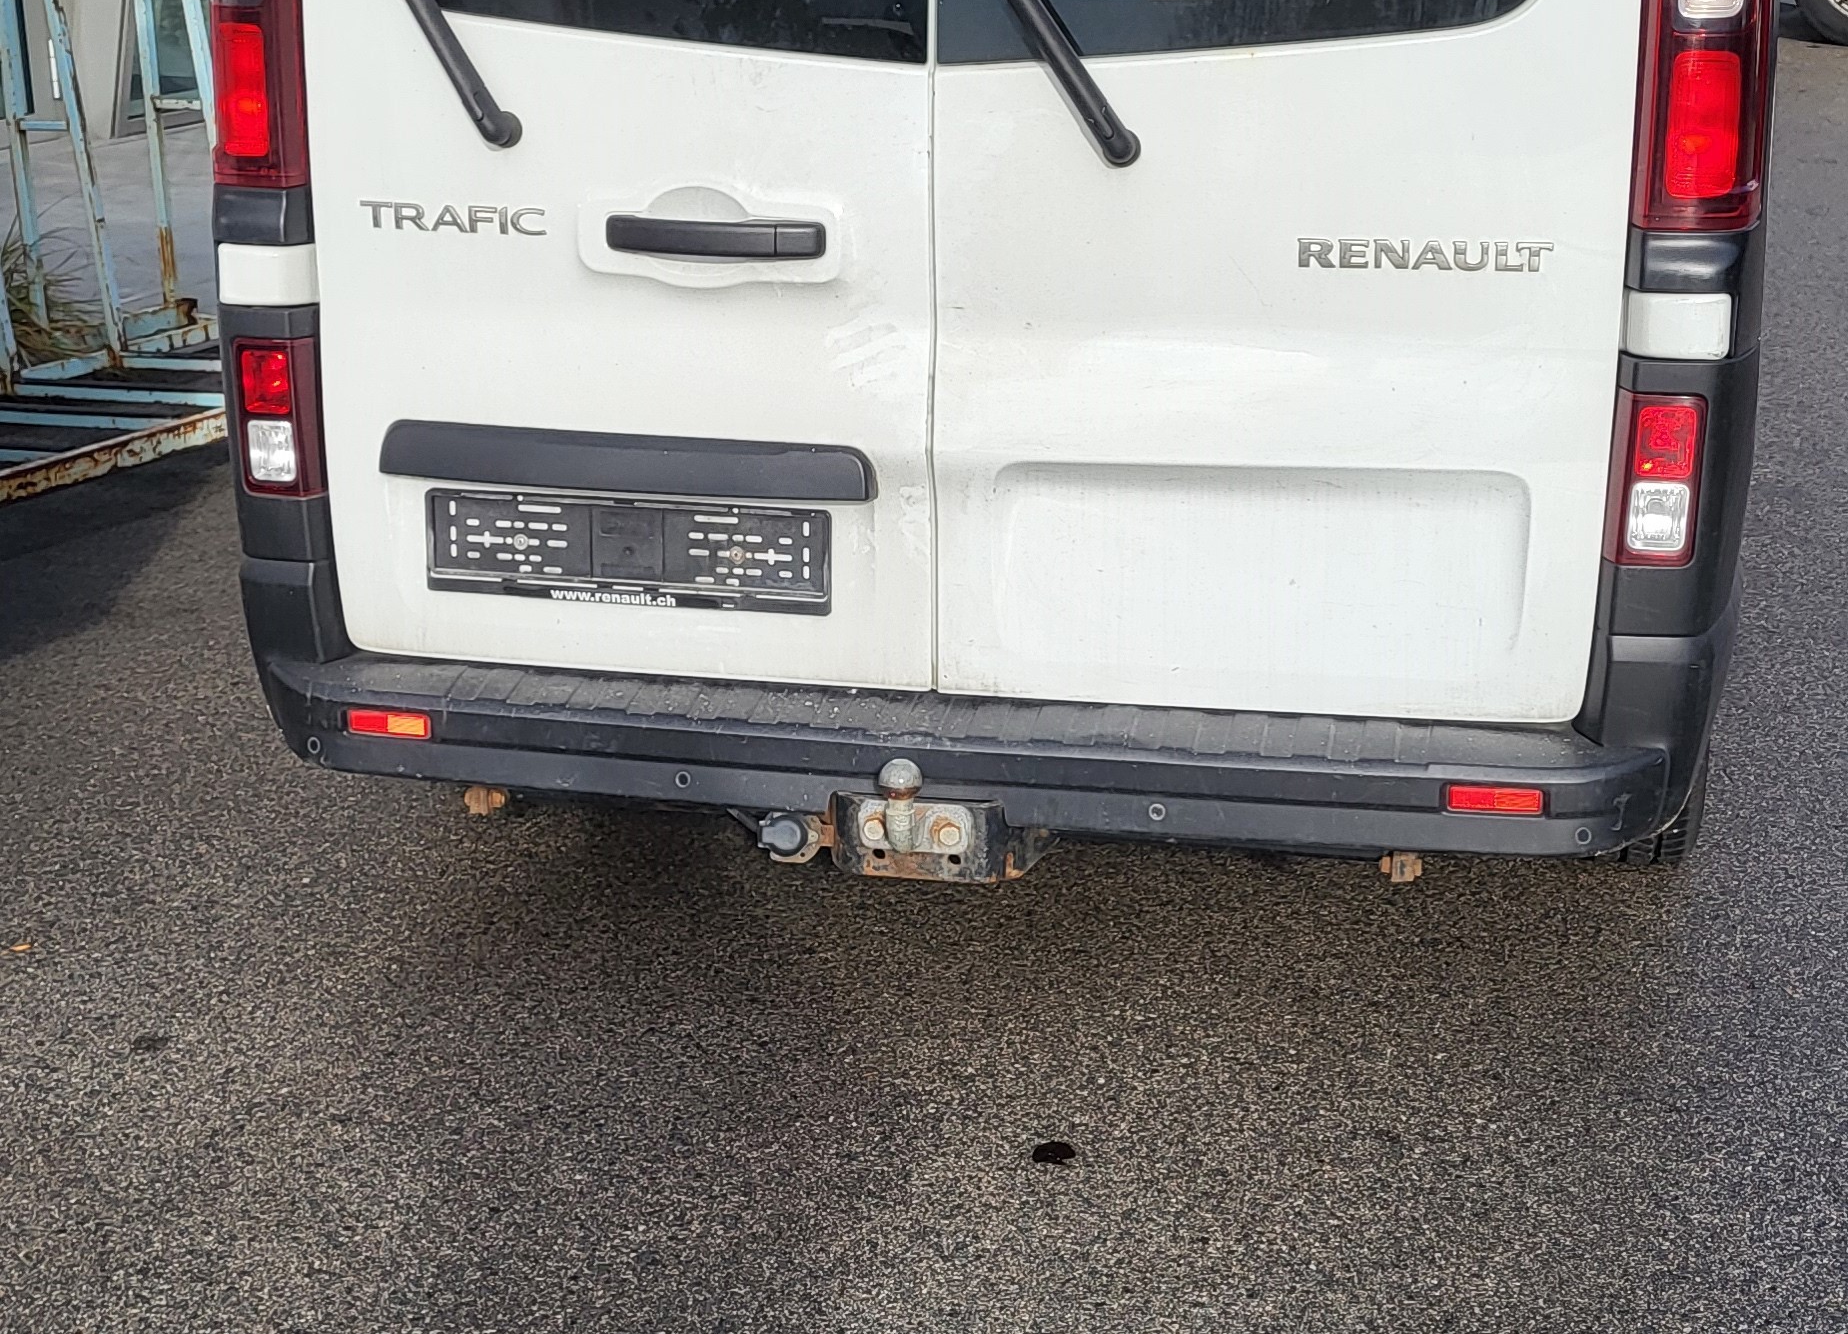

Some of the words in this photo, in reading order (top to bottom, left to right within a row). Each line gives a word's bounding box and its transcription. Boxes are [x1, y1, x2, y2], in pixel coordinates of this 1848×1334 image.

[360, 200, 547, 236] TRAFIC
[1297, 237, 1554, 273] RENAULT
[550, 589, 676, 607] www.renault.ch
